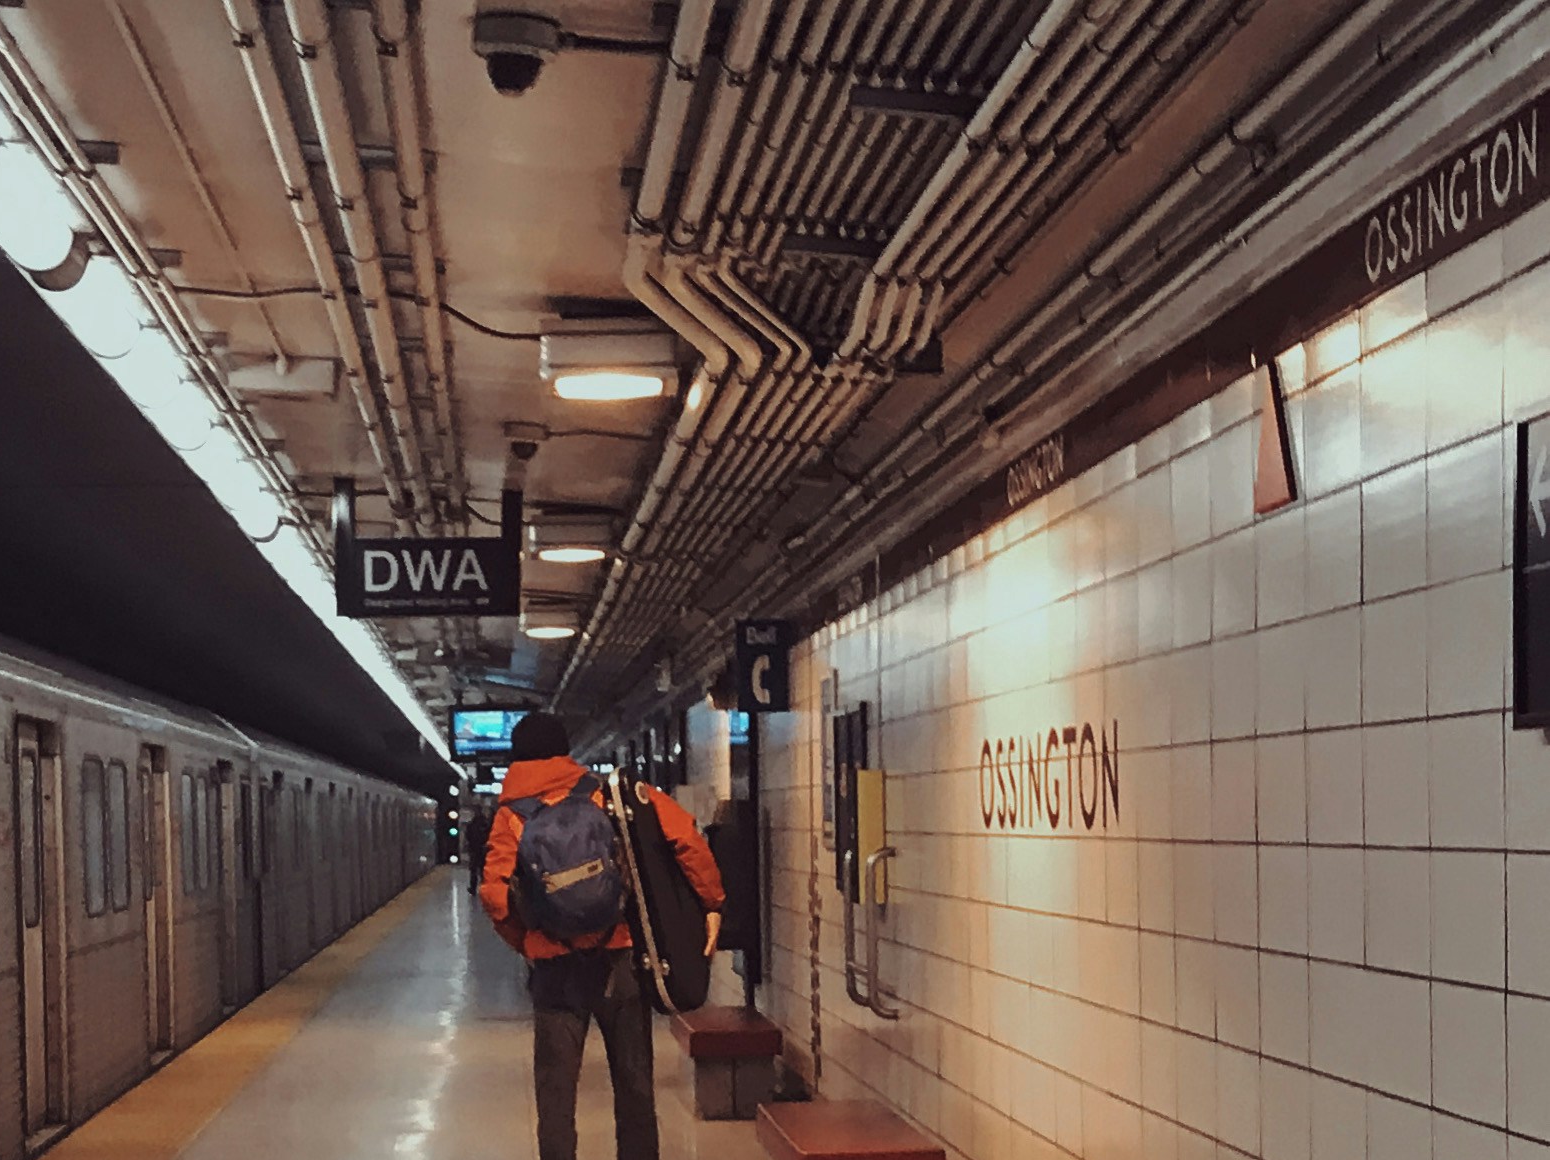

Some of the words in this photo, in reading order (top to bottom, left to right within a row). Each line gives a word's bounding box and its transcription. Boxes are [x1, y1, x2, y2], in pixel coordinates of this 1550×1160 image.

[1365, 109, 1537, 283] OSSINGTON
[364, 549, 489, 592] DWA
[979, 719, 1120, 831] OSSINGTON
